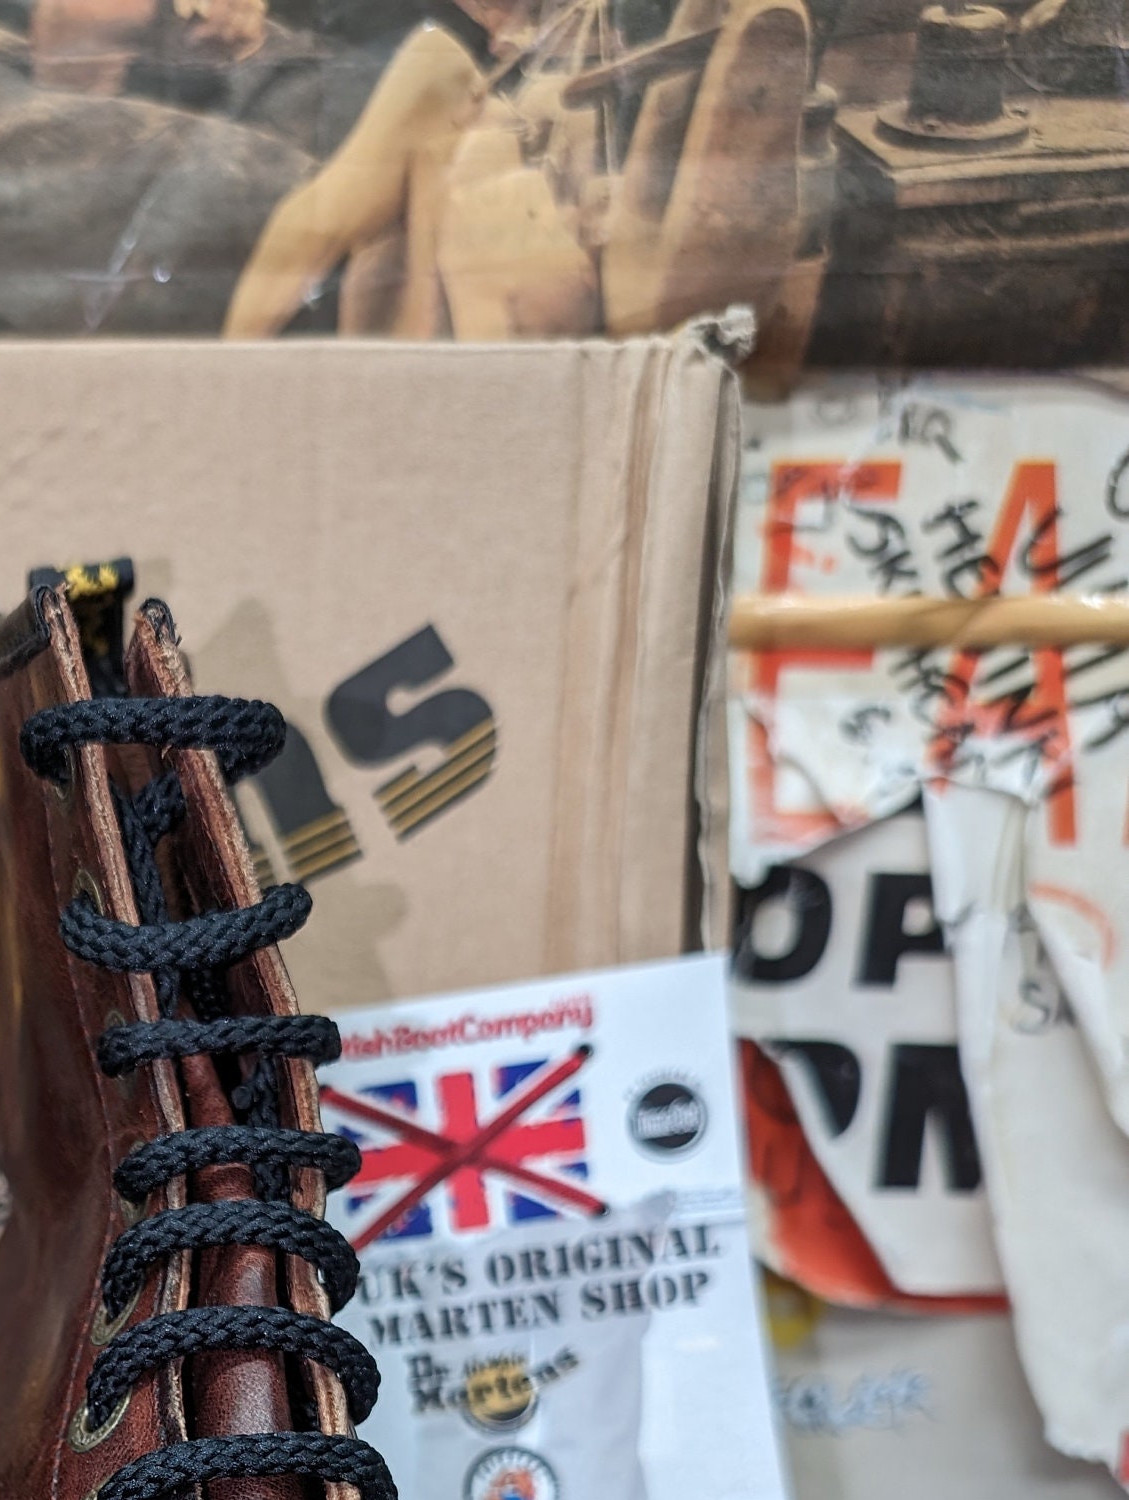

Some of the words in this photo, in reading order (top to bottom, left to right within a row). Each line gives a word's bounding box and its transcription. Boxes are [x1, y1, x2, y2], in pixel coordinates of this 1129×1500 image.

[485, 1224, 720, 1288] ORIGINAL
[371, 1293, 562, 1345] MARTEN
[581, 1271, 712, 1320] SHOP
